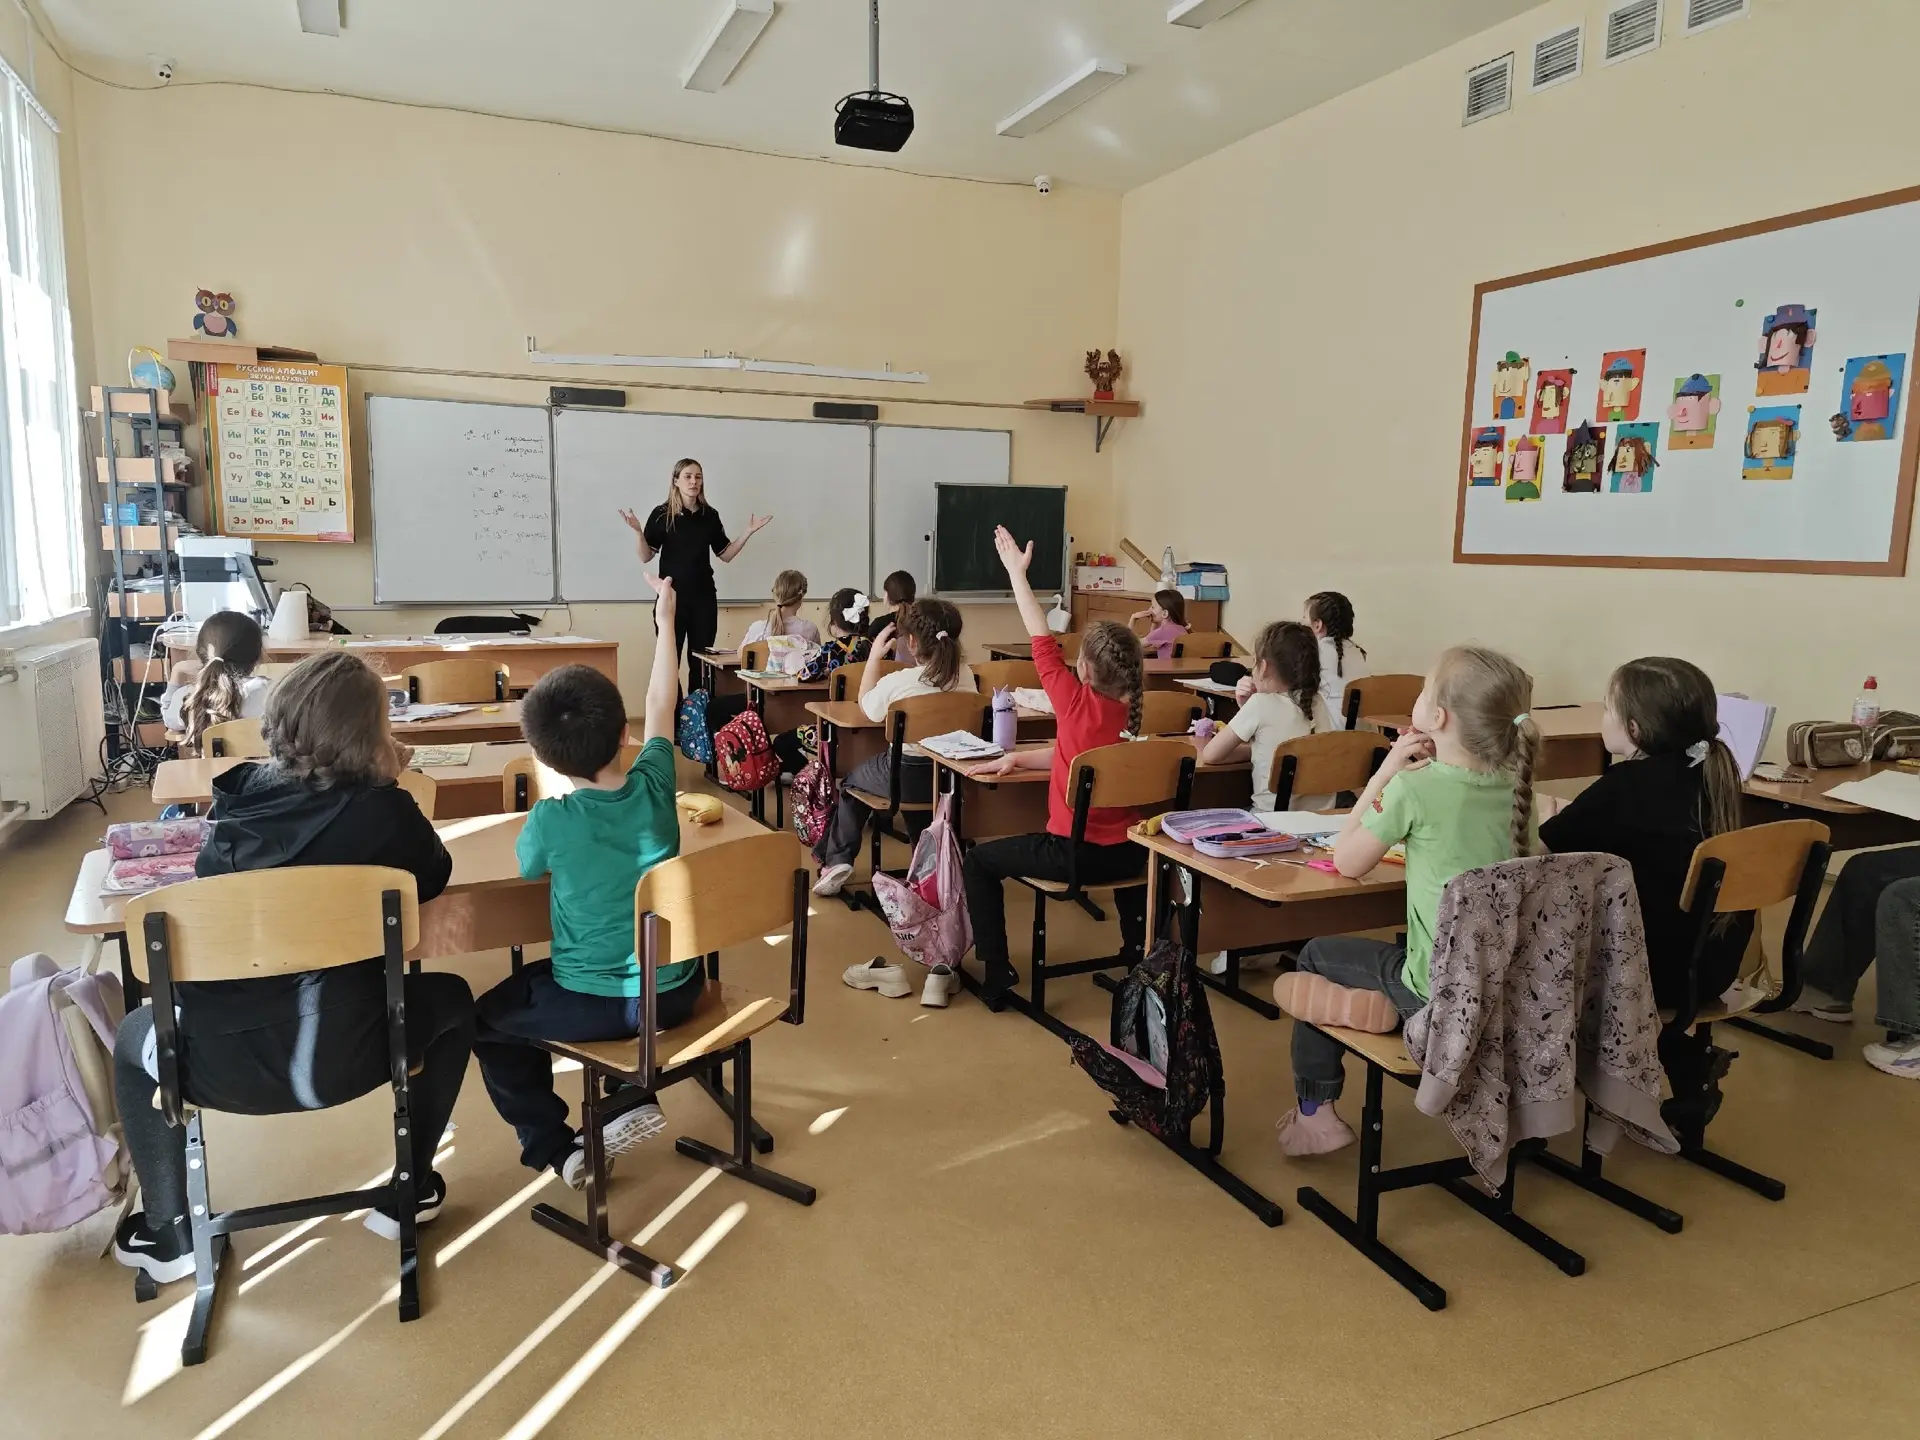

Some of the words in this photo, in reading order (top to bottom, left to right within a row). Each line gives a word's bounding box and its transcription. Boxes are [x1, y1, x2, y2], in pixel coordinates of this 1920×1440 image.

[236, 365, 275, 374] РУССКИЙ
[277, 367, 319, 376] АЛФАВИТ
[322, 388, 335, 396] Дд
[322, 398, 336, 406] Дд
[251, 408, 263, 418] Ёё
[322, 413, 334, 421] Ии
[280, 449, 292, 458] Рр
[280, 460, 292, 468] Рр
[231, 473, 242, 482] Уу
[255, 471, 271, 479] Фф
[301, 476, 314, 484] Цц
[280, 496, 290, 504] Ъ
[304, 497, 314, 505] Ы
[328, 498, 336, 506] Ь
[233, 516, 246, 524] Ээ
[254, 517, 273, 525] Юю
